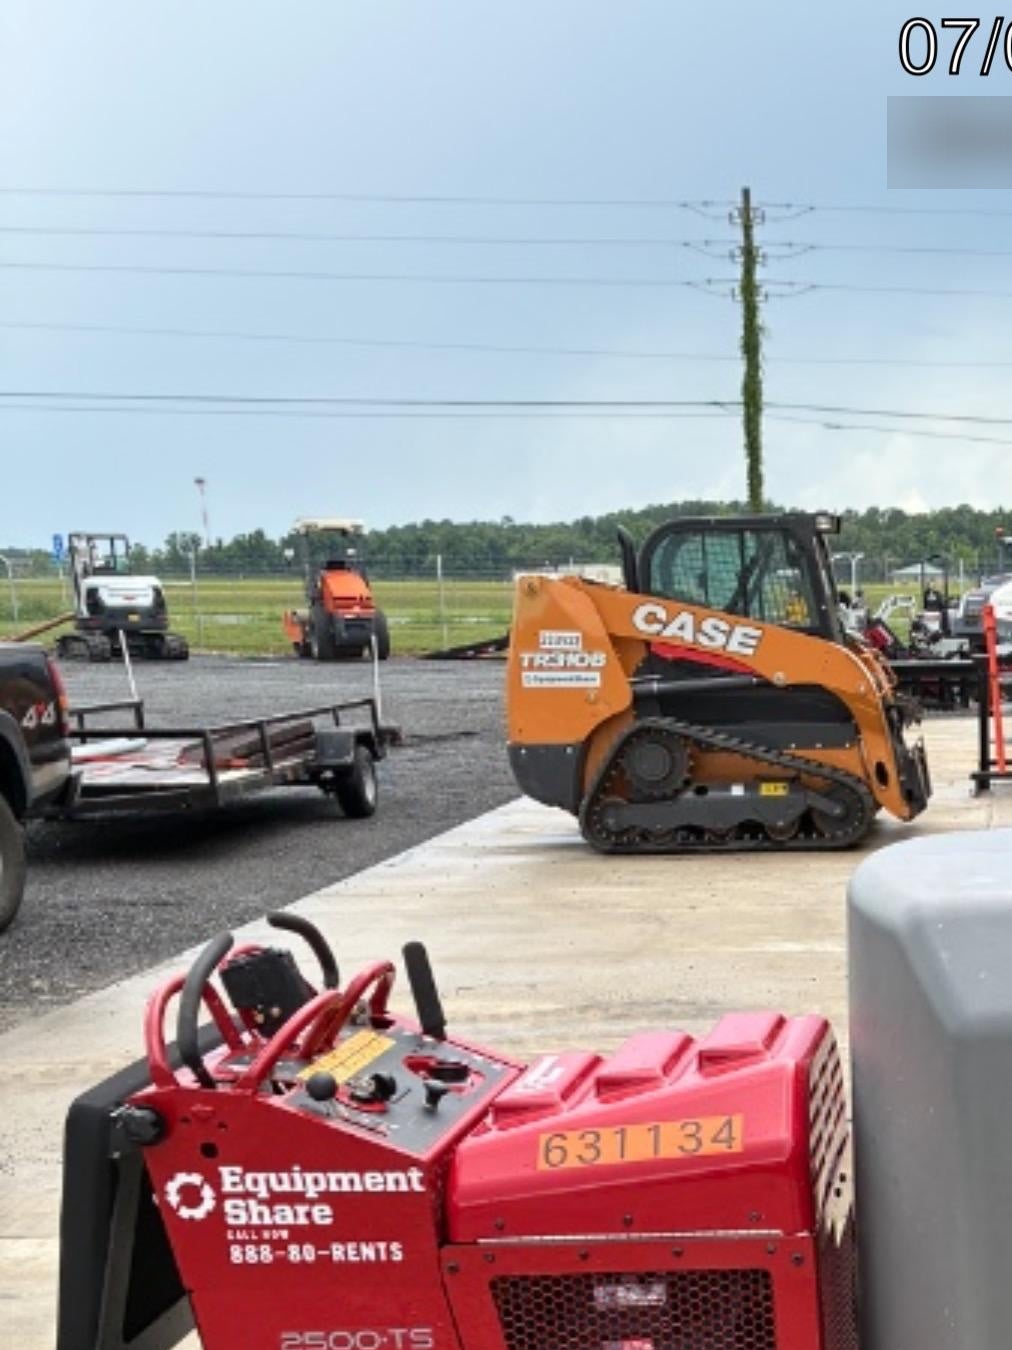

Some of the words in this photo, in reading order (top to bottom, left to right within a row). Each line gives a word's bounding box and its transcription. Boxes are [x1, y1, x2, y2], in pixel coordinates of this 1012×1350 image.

[632, 604, 763, 657] CASE
[543, 1116, 736, 1168] 631134
[218, 1165, 426, 1199] Equipment
[223, 1199, 334, 1226] Share
[230, 1241, 404, 1265] 888-80-RENTS
